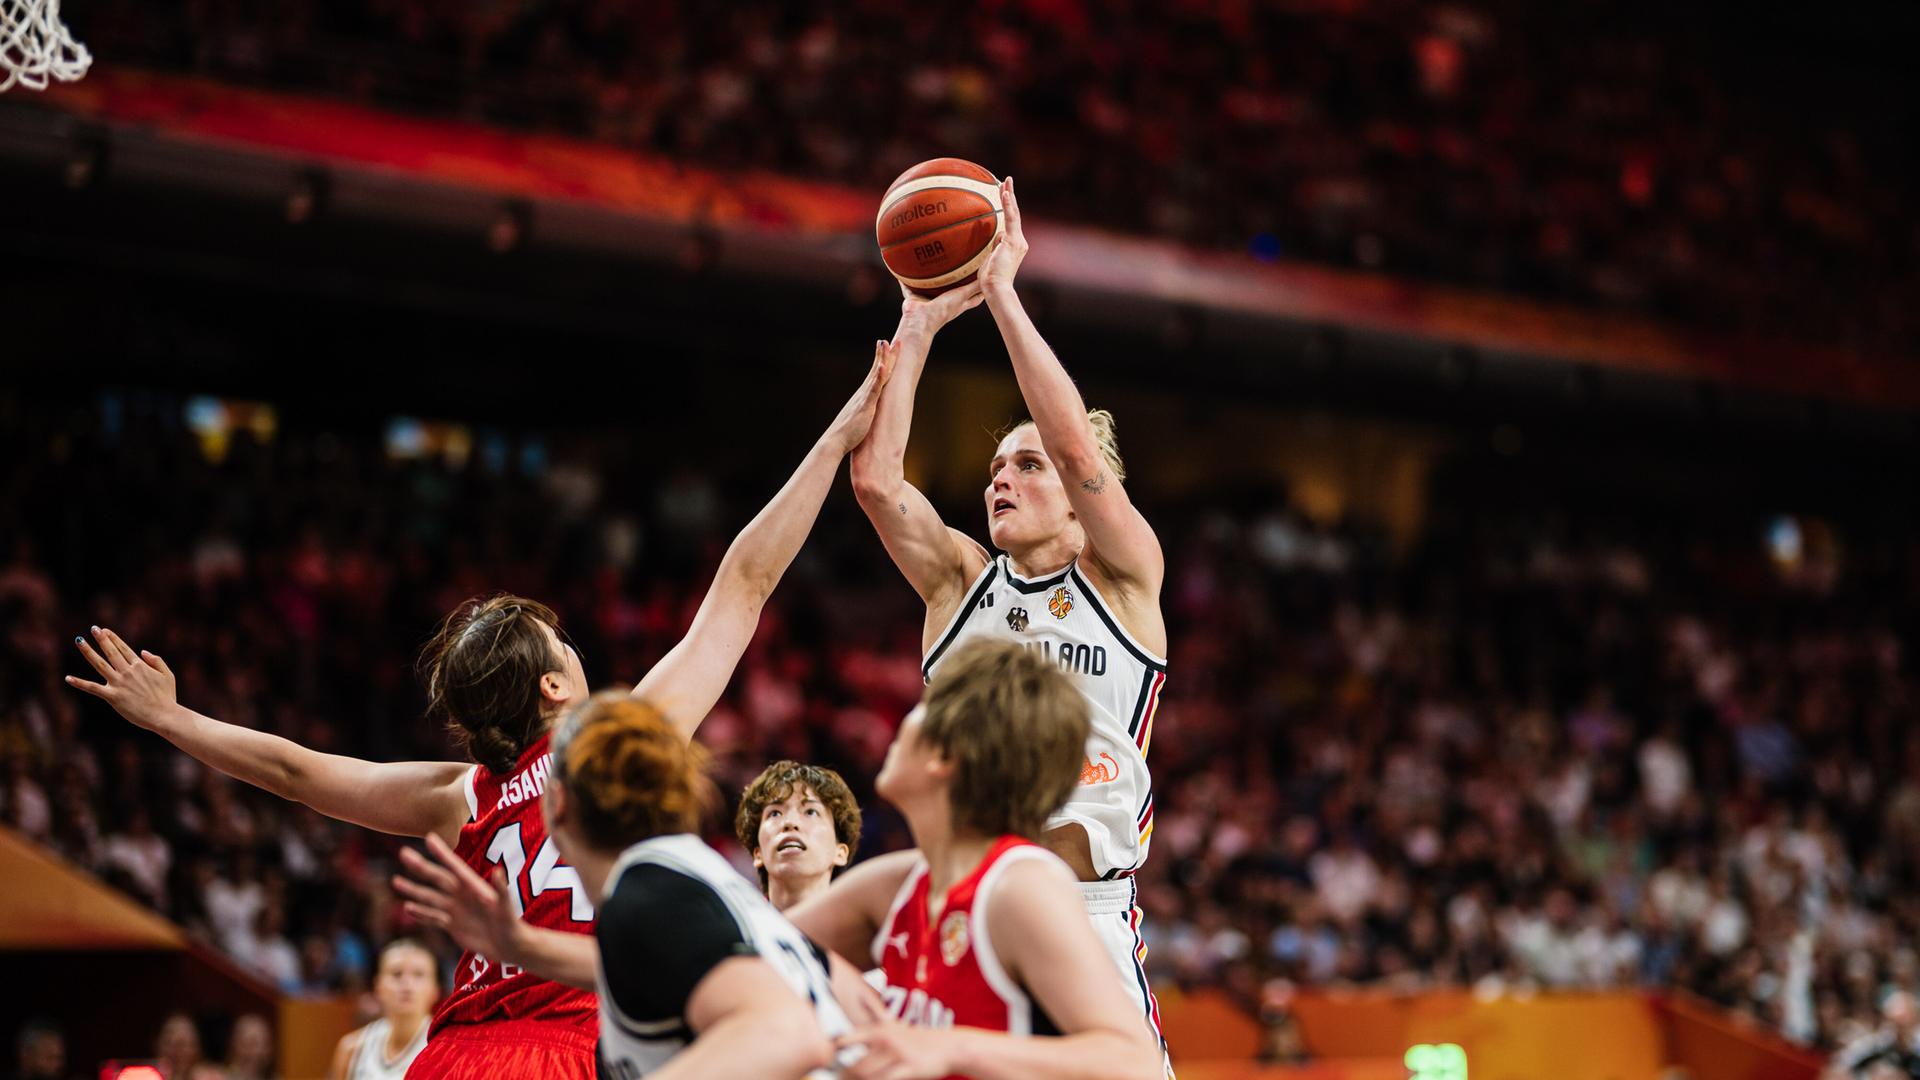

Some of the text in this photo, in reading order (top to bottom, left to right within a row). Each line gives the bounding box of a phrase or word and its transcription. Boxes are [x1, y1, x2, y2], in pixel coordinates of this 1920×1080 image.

[891, 200, 947, 229] molten
[913, 240, 945, 261] FIBA
[497, 752, 554, 811] ASAHI
[485, 822, 595, 922] 14
